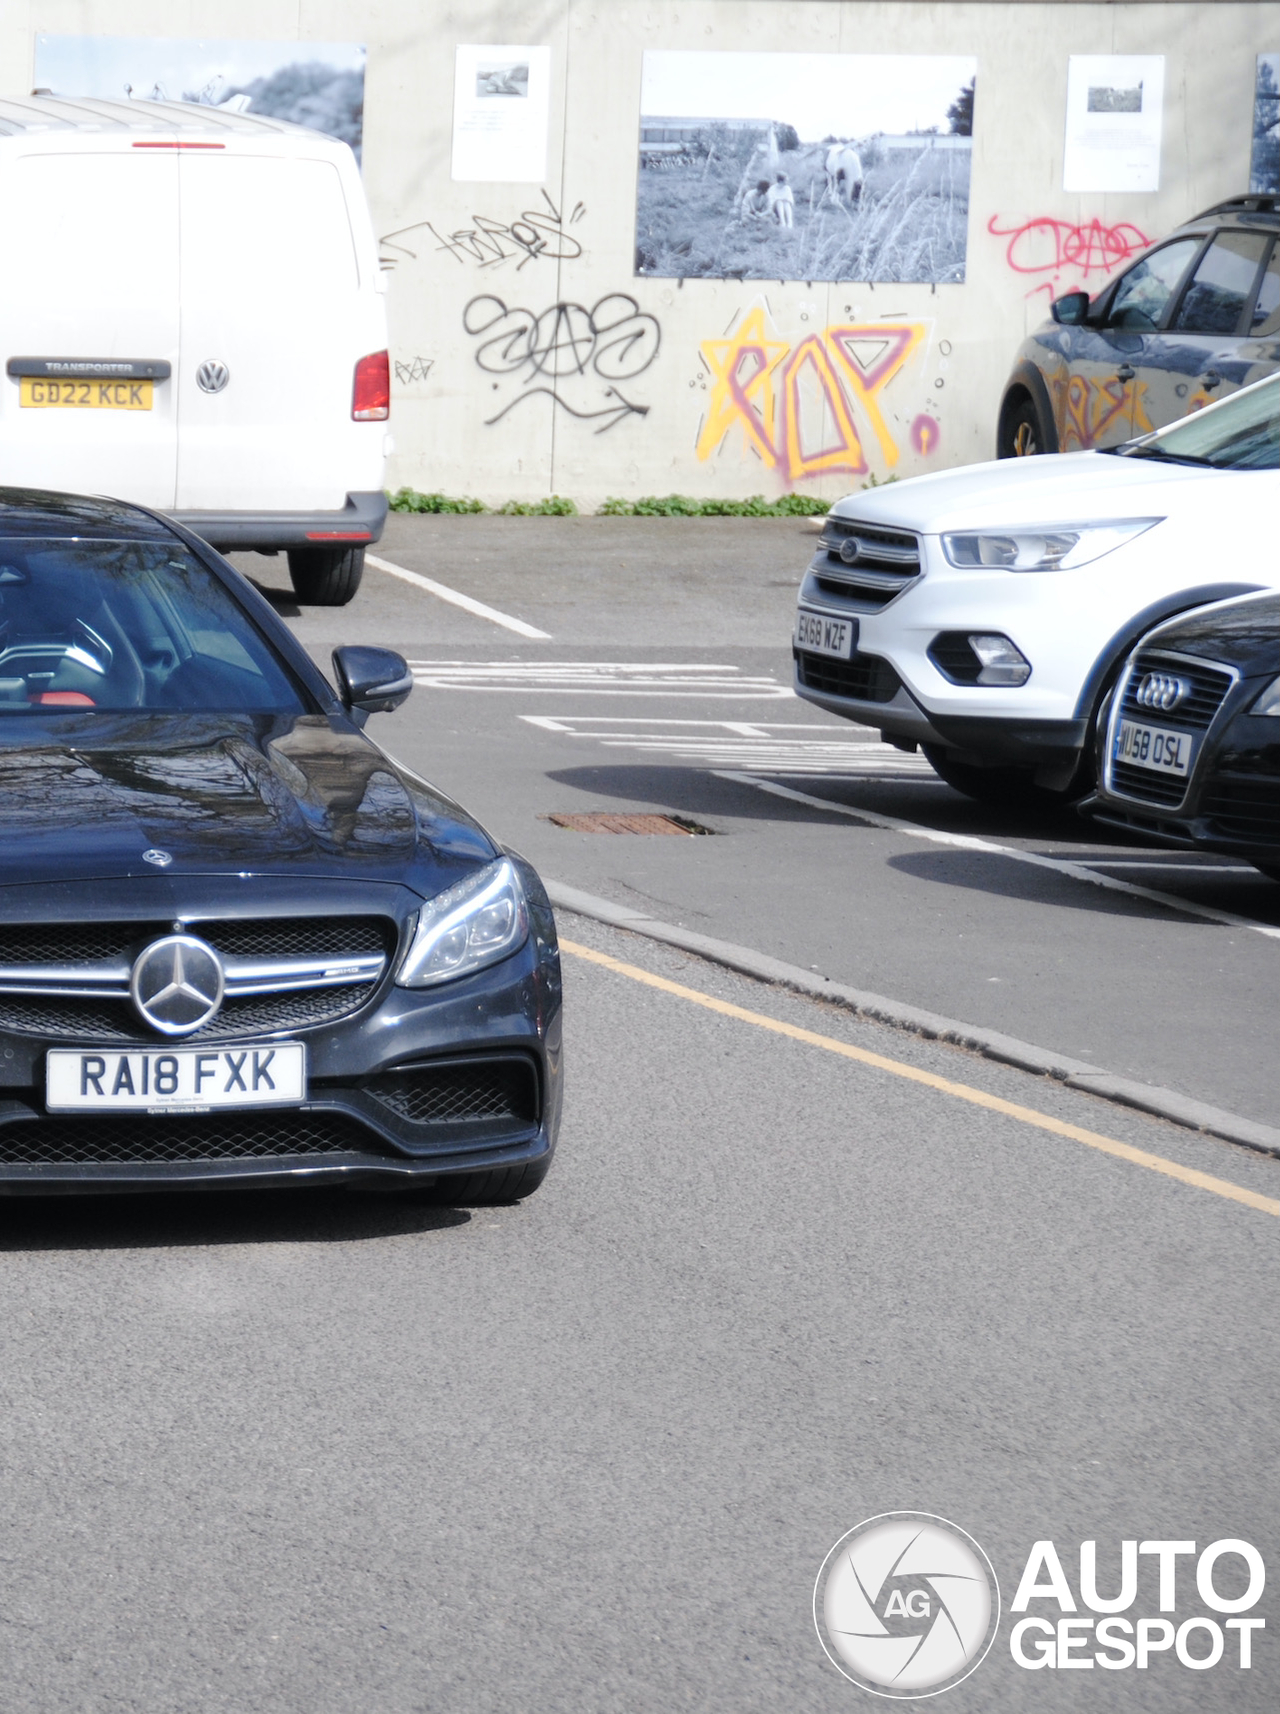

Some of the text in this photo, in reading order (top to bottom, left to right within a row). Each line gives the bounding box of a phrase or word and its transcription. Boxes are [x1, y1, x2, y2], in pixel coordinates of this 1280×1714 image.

[45, 361, 133, 373] TRANSPORTER
[31, 381, 144, 406] GD22 KCK
[1152, 733, 1185, 769] OSL
[80, 1049, 276, 1096] RA18 FXK
